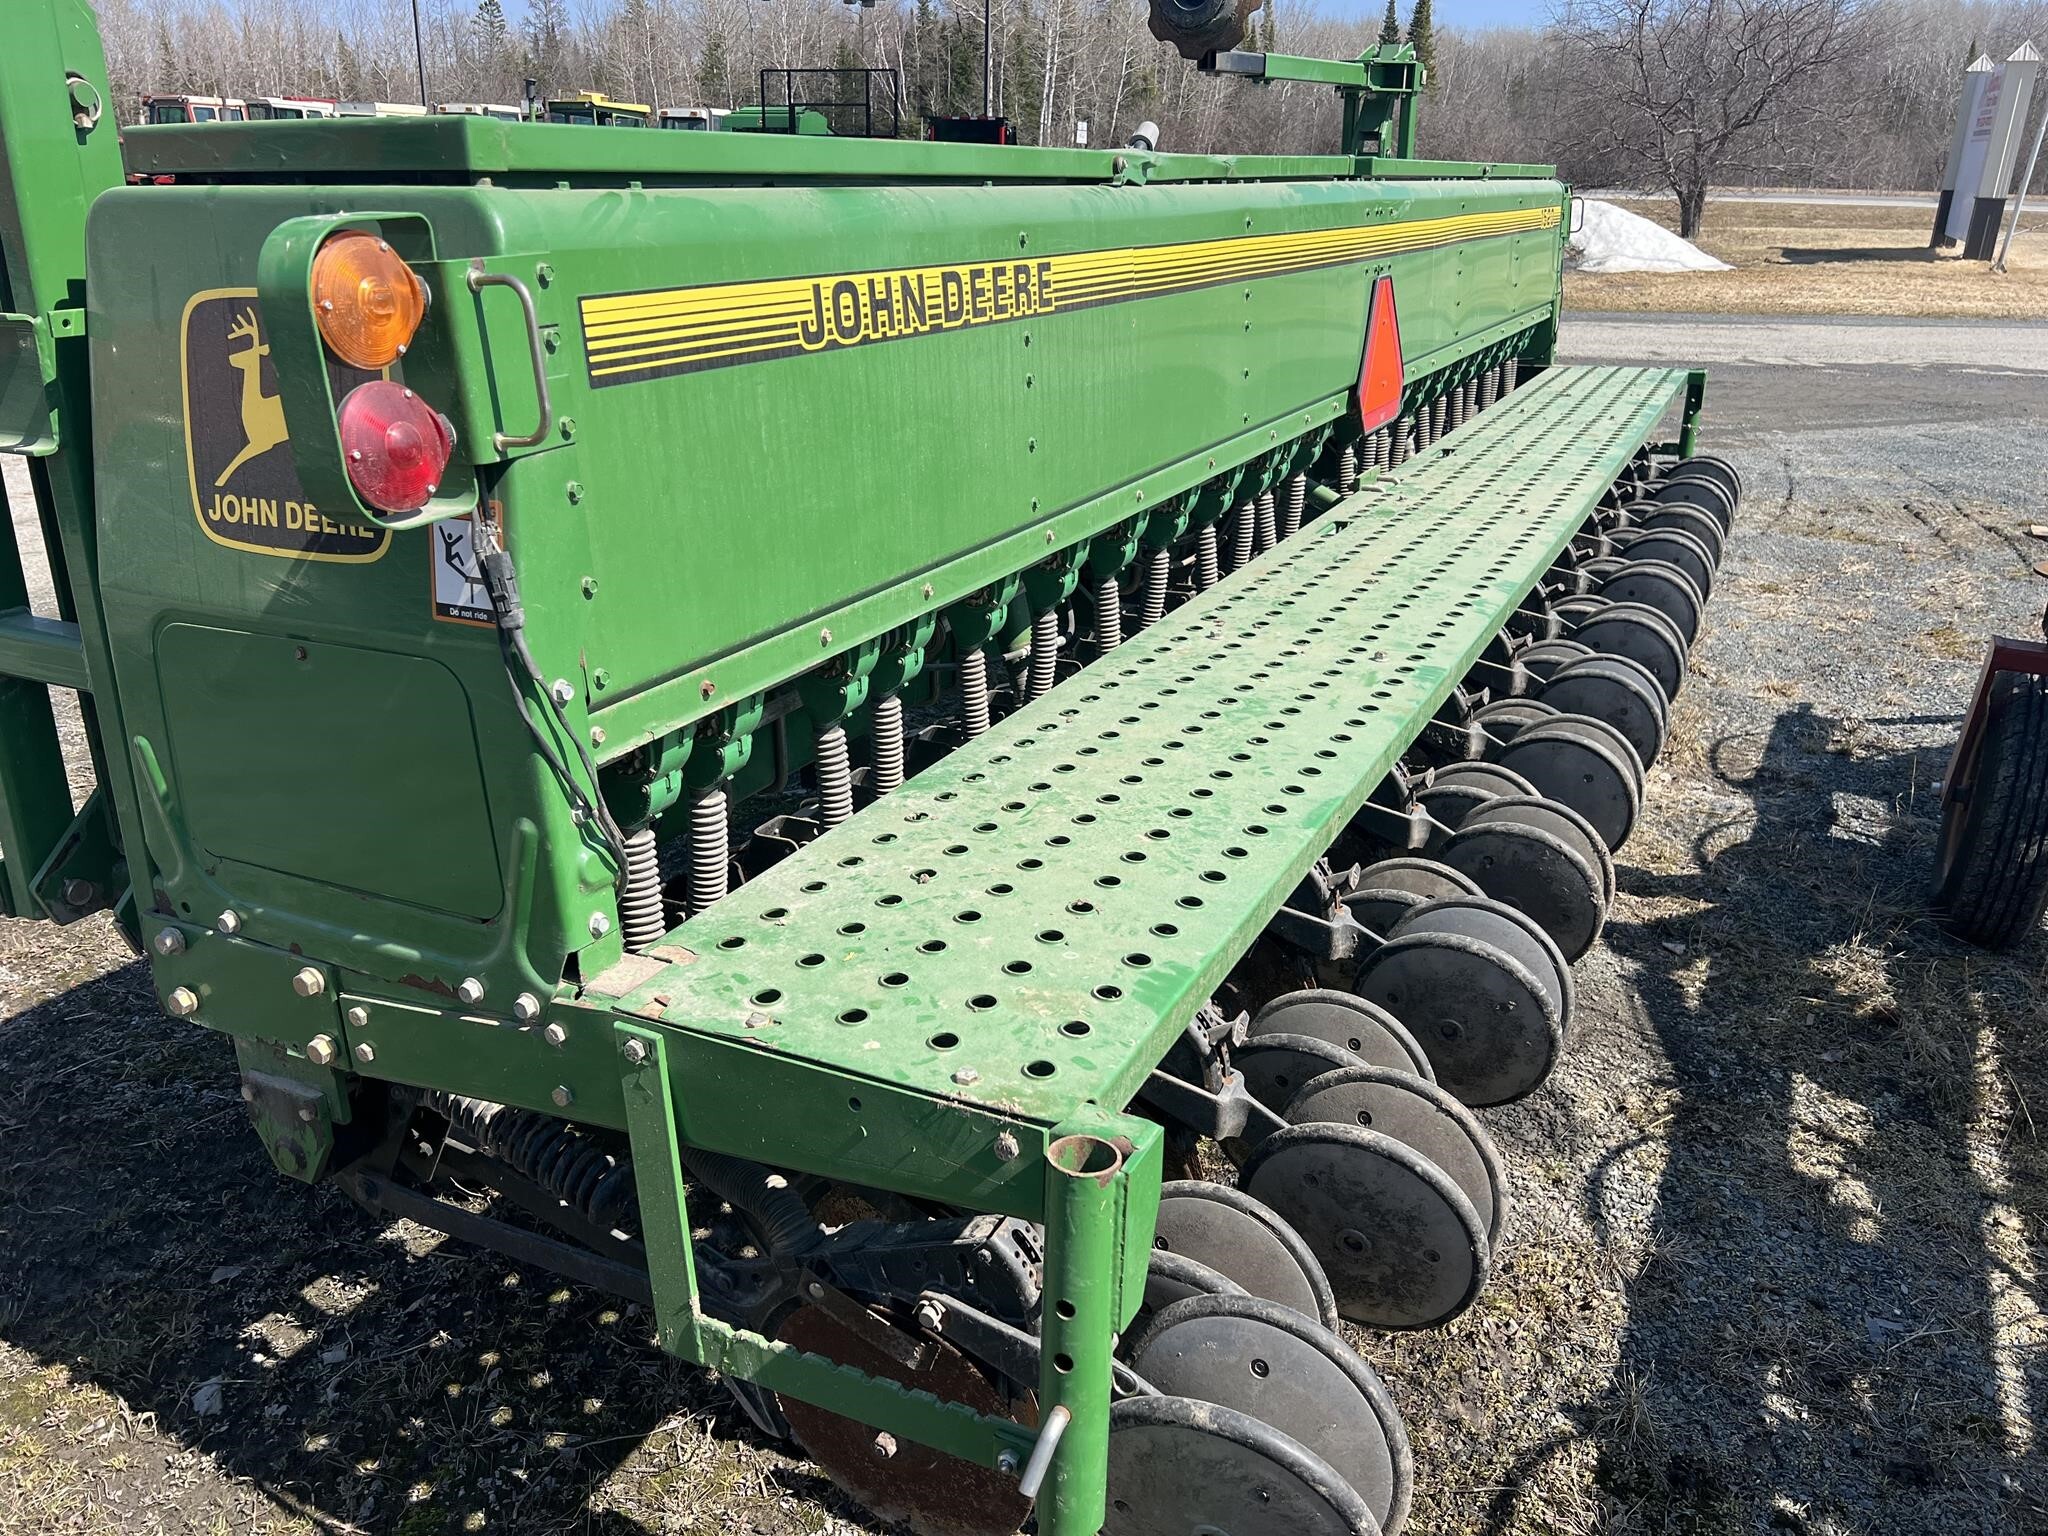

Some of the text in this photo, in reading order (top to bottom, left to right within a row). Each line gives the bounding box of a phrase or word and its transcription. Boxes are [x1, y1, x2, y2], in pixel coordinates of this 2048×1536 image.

[801, 261, 1053, 346] JOHN DEERE
[208, 493, 278, 527] JOHN
[449, 607, 488, 621] Do not ride
